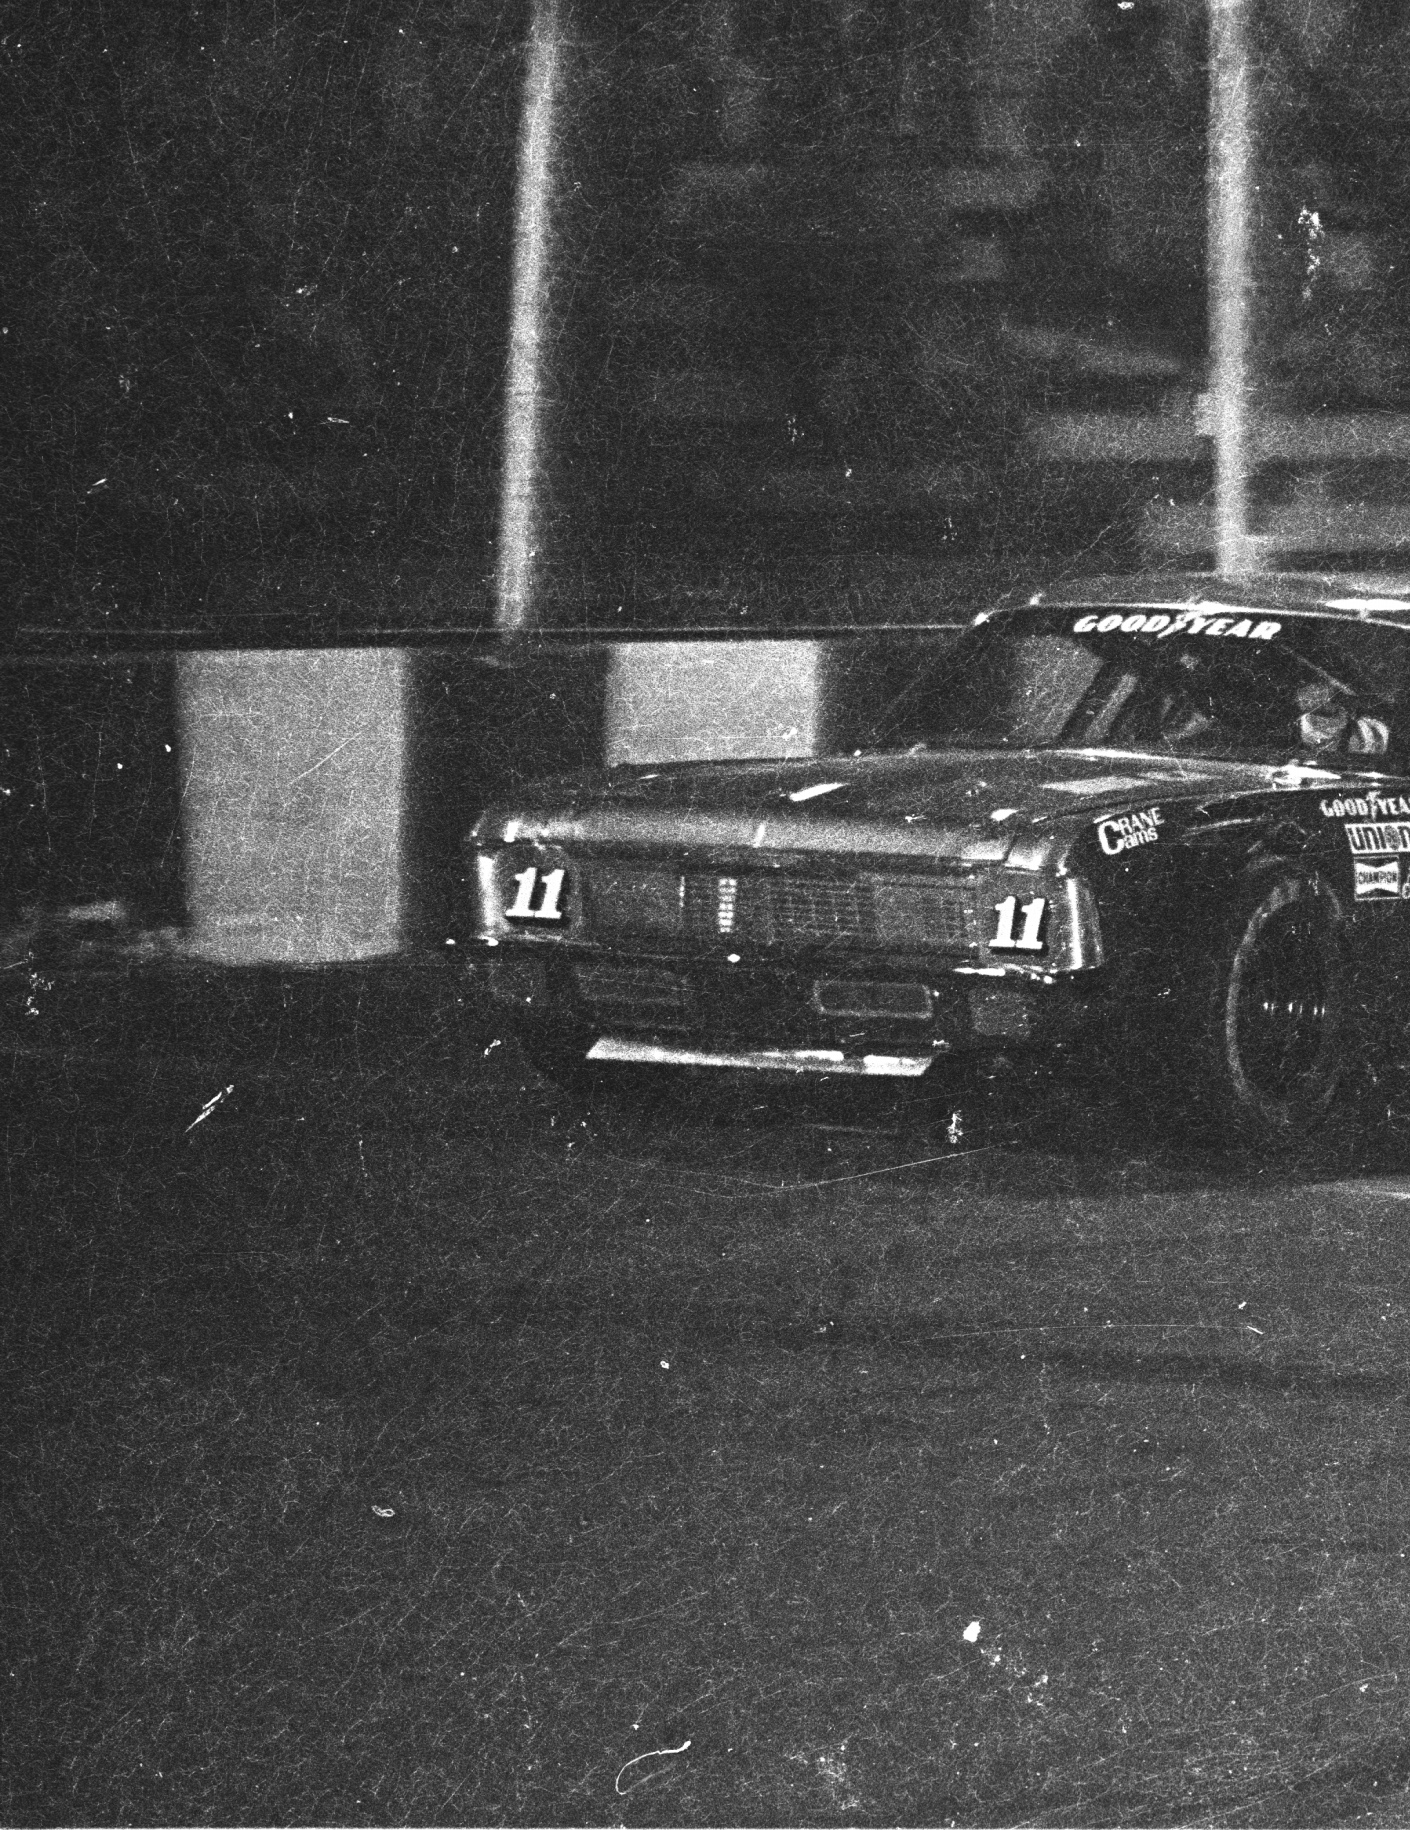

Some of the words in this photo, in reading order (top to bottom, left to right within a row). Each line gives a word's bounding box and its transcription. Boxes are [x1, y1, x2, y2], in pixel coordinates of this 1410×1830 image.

[1072, 611, 1282, 640] GOODYEAR
[505, 866, 565, 919] 11
[988, 895, 1045, 950] 11
